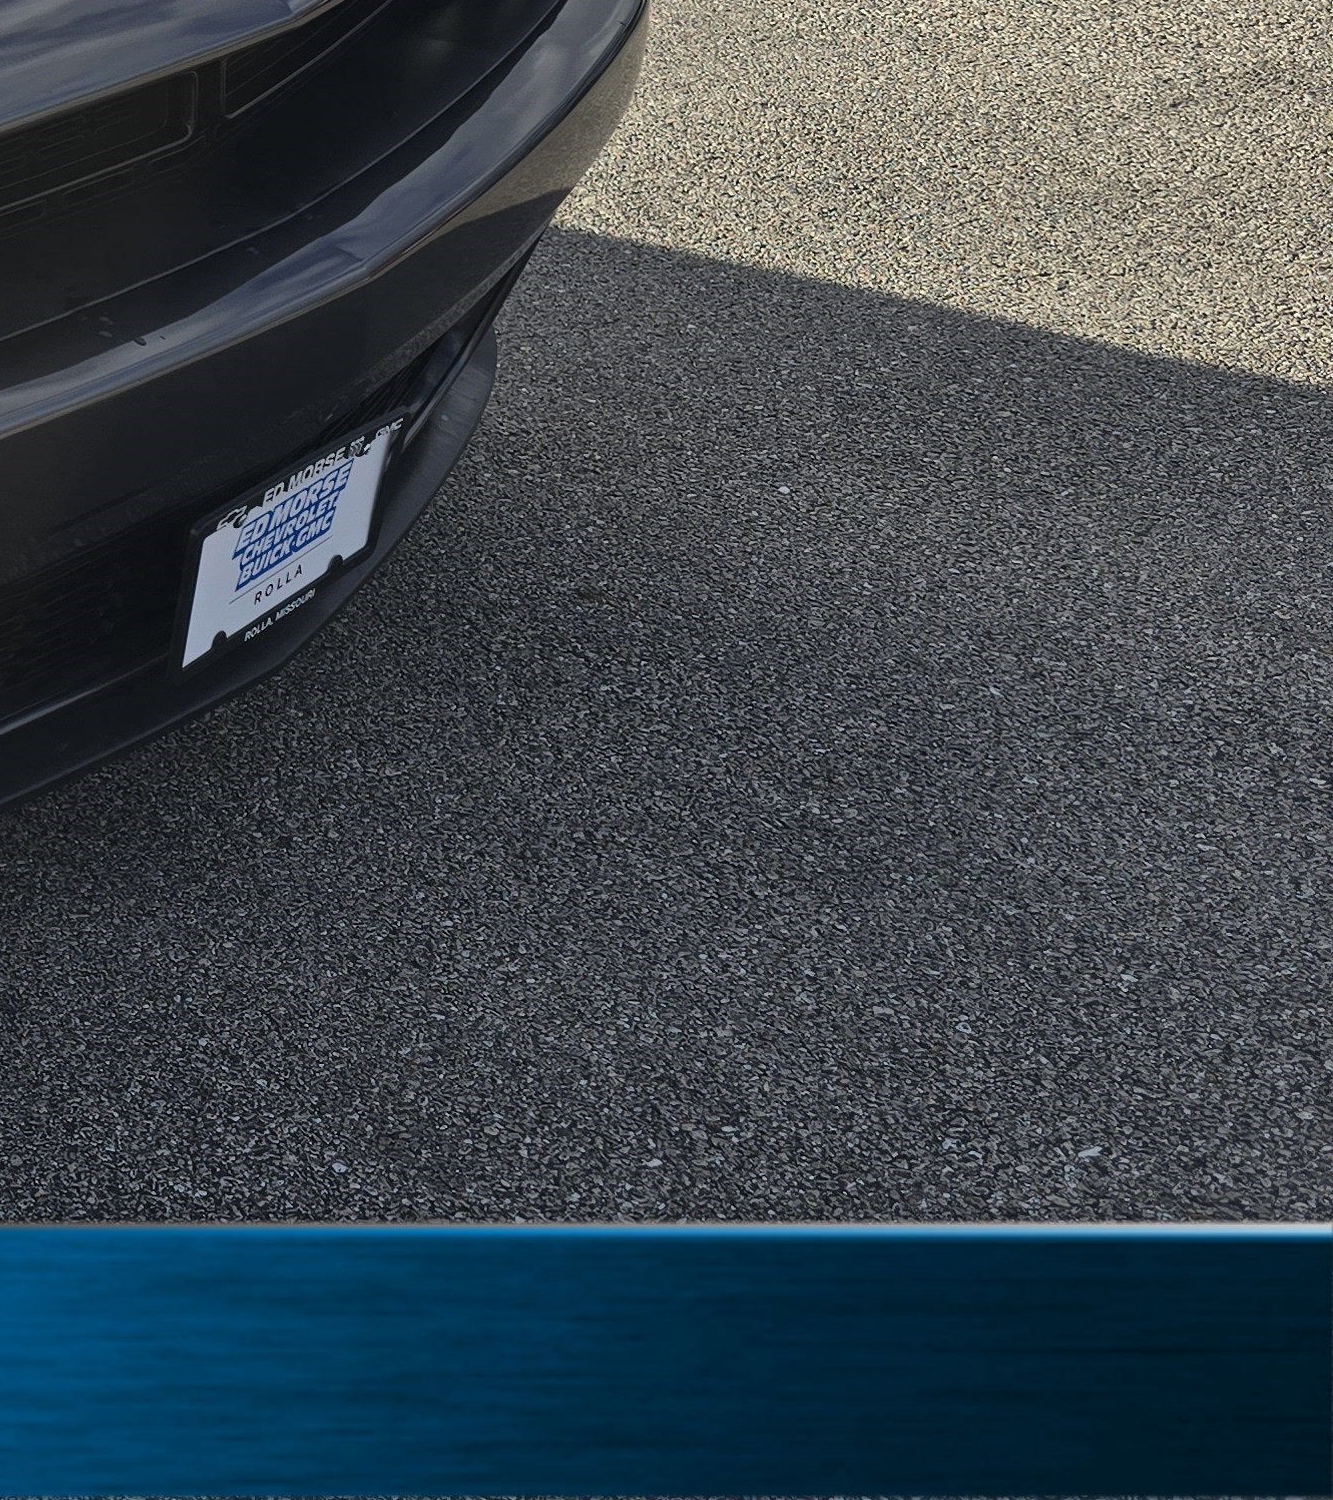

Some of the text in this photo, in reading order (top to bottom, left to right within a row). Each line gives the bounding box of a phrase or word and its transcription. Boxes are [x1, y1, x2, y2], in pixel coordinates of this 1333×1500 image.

[375, 417, 404, 440] GMC
[263, 446, 346, 505] ED MORSE
[237, 460, 353, 552] ED MORSE
[241, 491, 339, 565] CHEVROLET
[254, 564, 303, 605] ROLLA
[276, 588, 316, 621] MISSOURI
